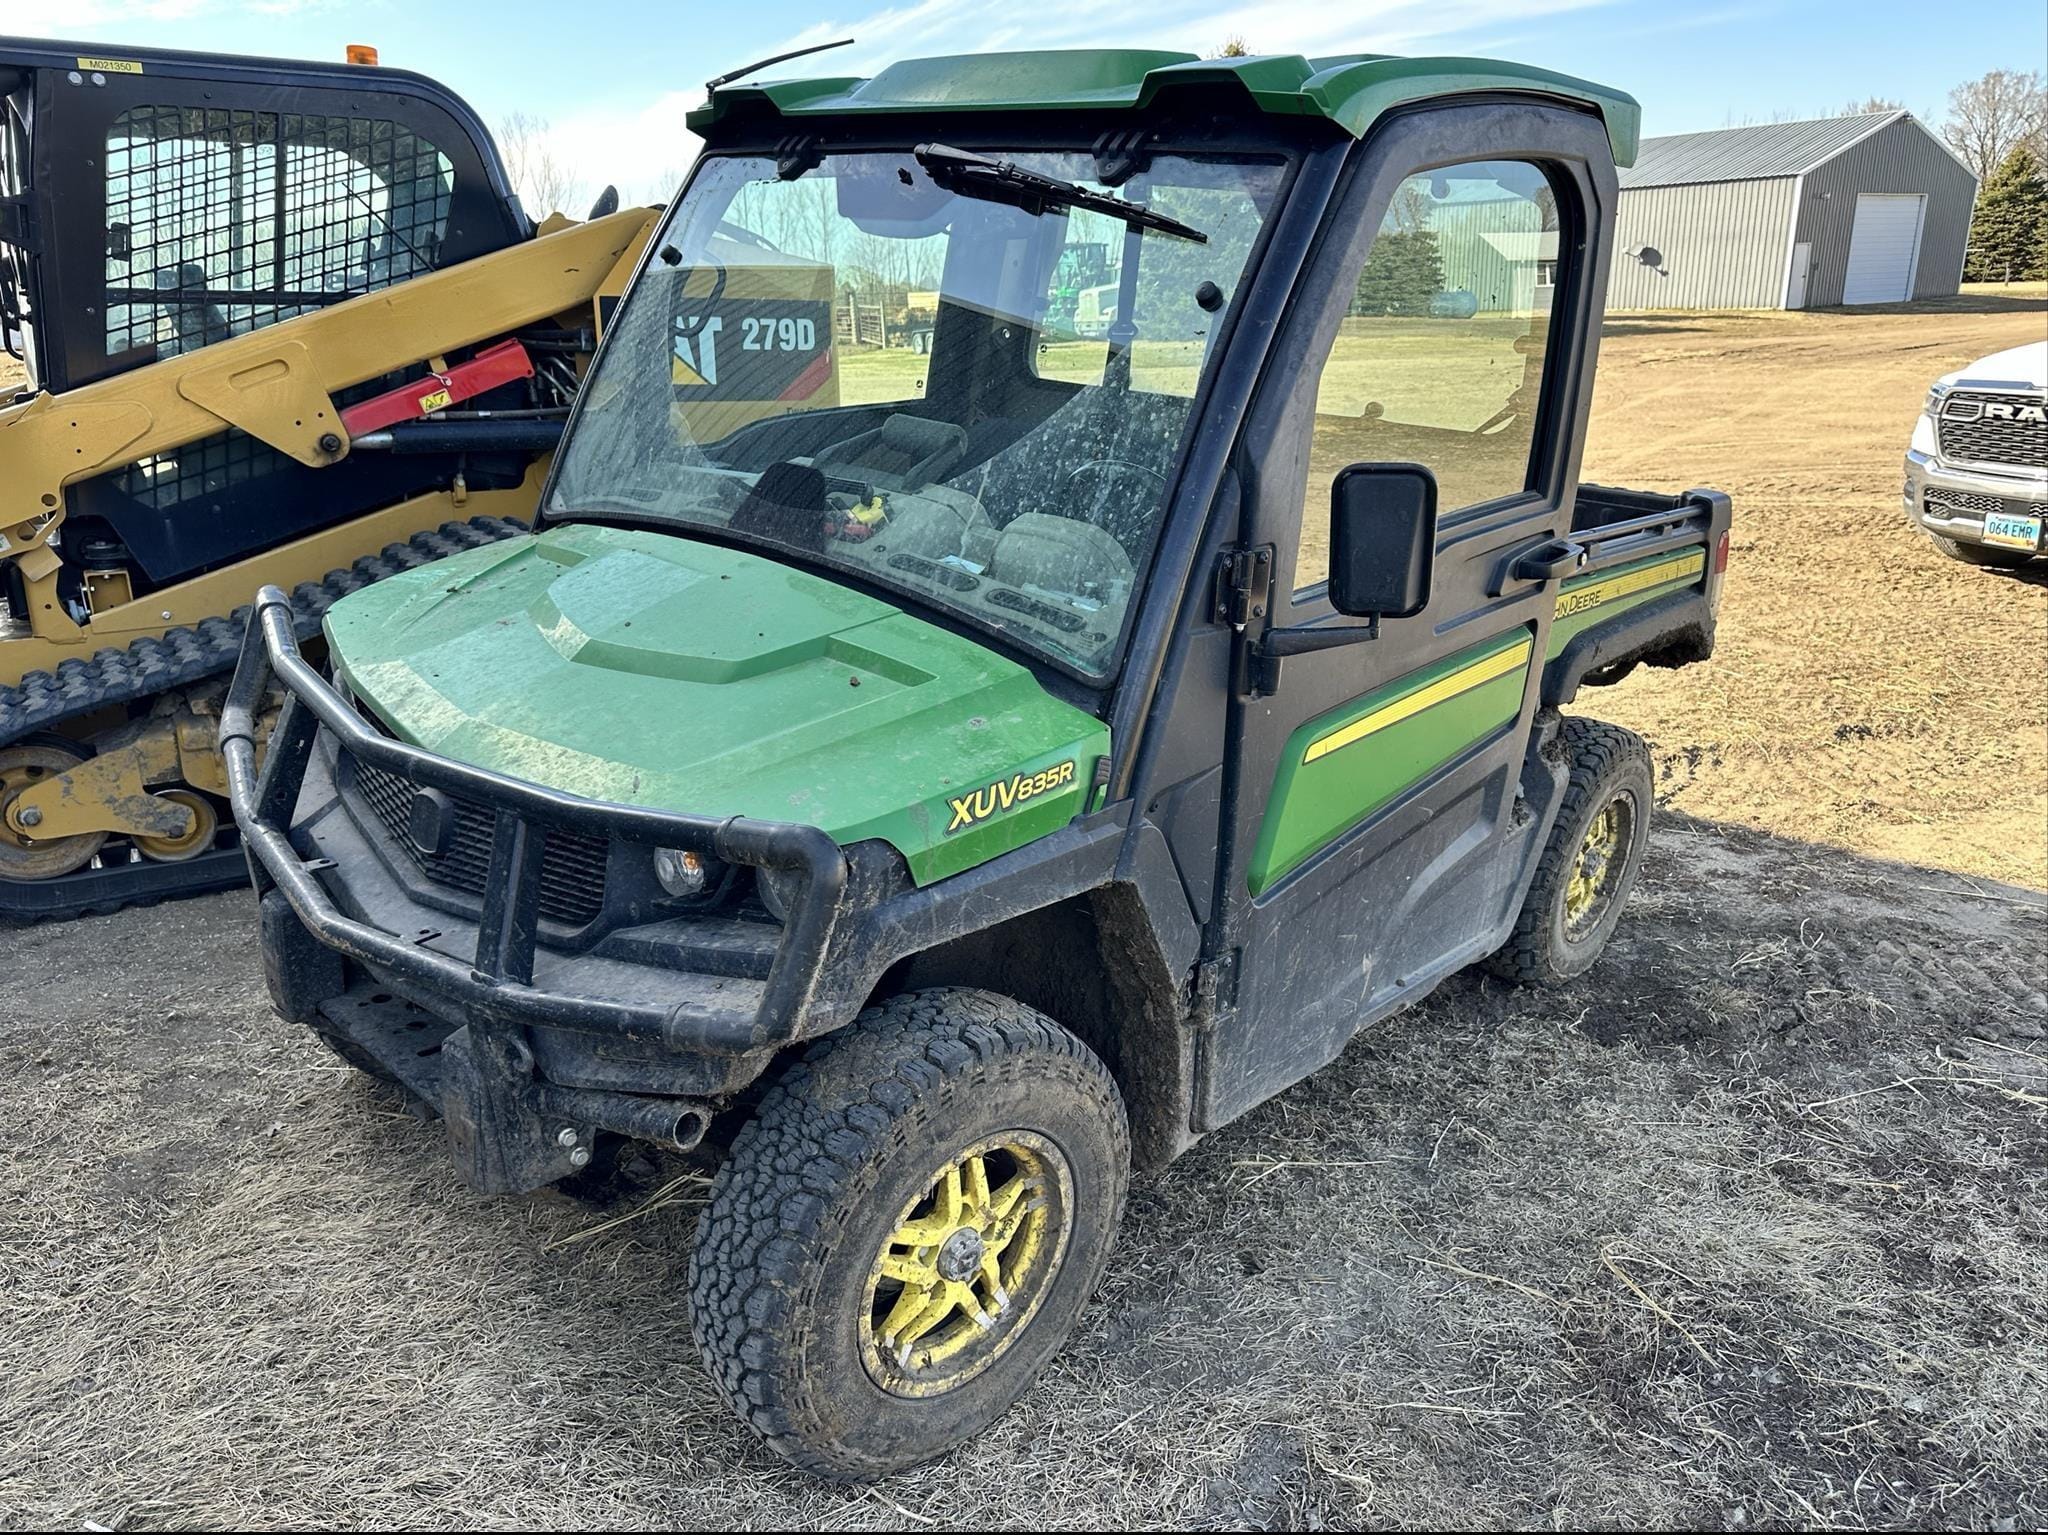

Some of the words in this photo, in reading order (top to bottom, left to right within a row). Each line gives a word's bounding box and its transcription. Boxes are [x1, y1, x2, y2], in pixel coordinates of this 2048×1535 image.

[89, 60, 132, 71] M021350
[742, 317, 816, 351] 279D
[1984, 402, 2047, 422] RA
[1989, 521, 2009, 536] 064
[1569, 590, 1602, 612] DEERE
[946, 760, 1075, 833] XUV835R
